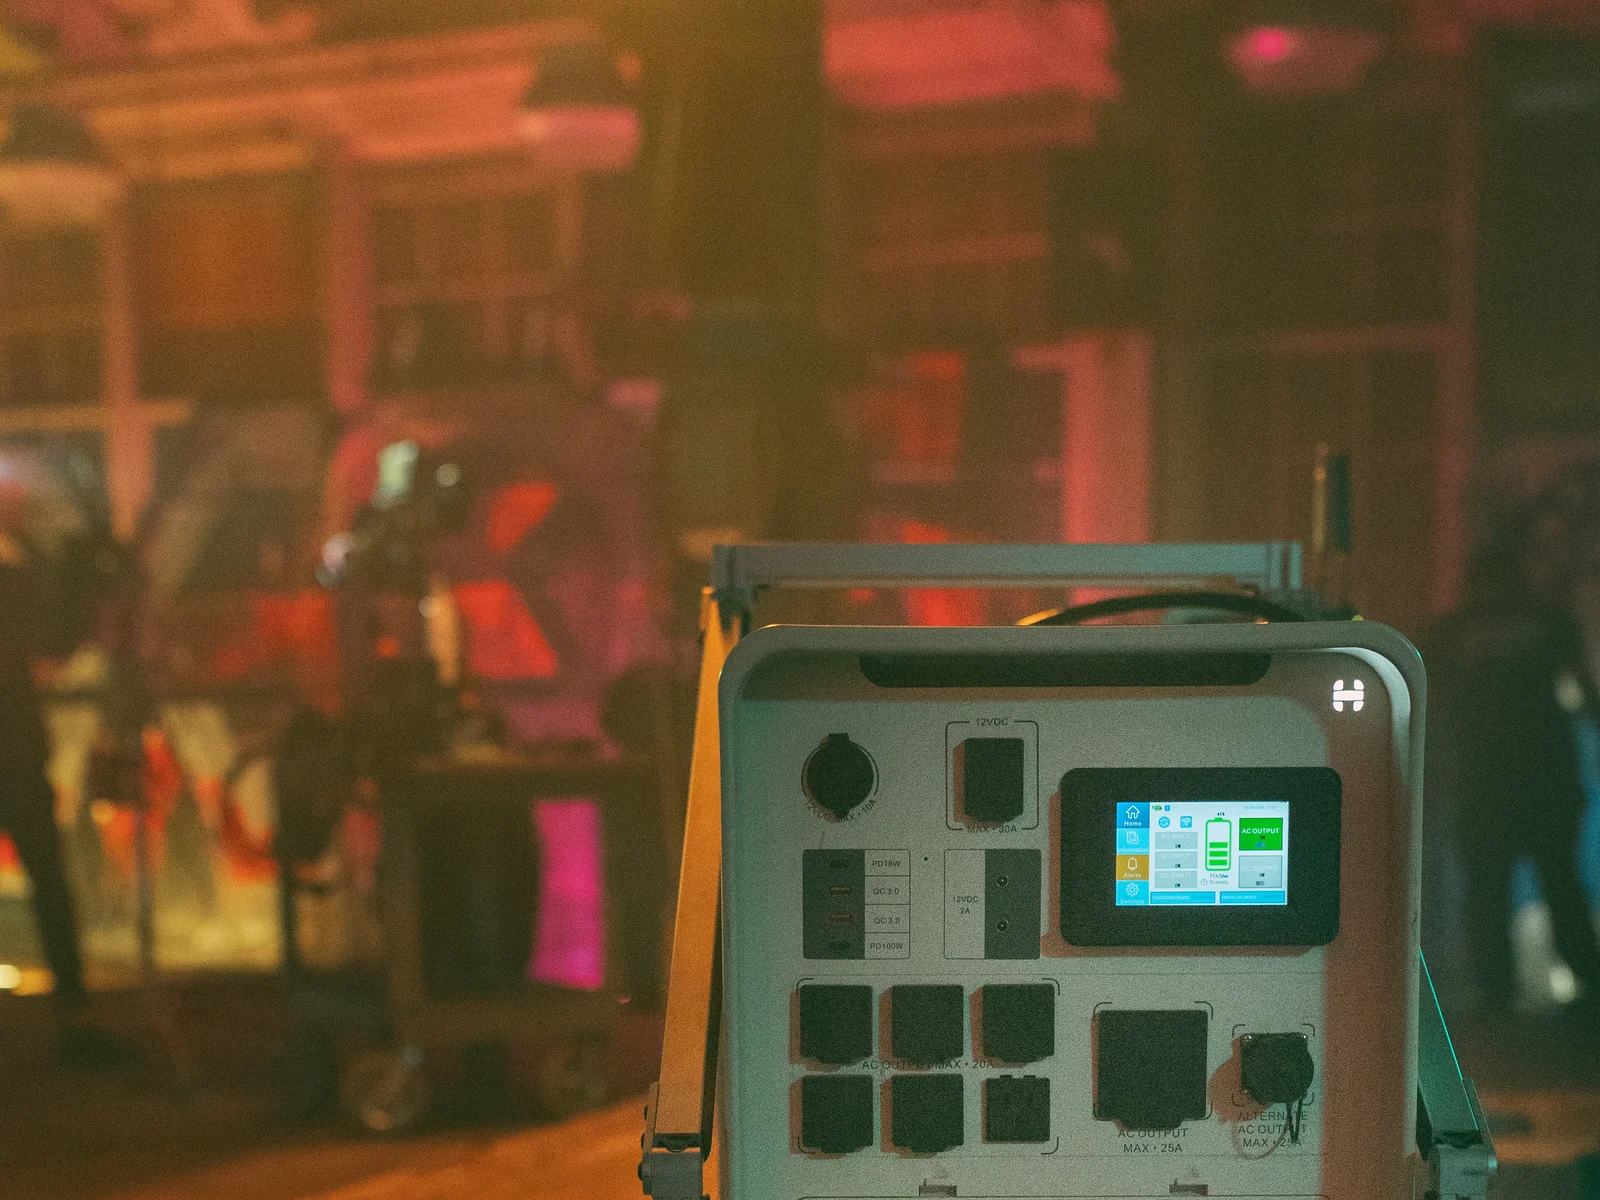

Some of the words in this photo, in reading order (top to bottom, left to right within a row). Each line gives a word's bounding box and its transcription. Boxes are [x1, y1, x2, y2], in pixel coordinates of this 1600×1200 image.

[976, 717, 1008, 727] 12VDC
[862, 799, 878, 815] 10A
[967, 825, 989, 834] MAX
[999, 825, 1018, 833] 30A
[871, 859, 901, 867] PD18W
[952, 895, 979, 904] 12VDC
[960, 906, 971, 915] 2A
[869, 942, 904, 950] PD100W
[862, 1060, 879, 1069] AC
[972, 1060, 994, 1069] 20A
[1118, 1128, 1136, 1139] AC
[1138, 1127, 1189, 1138] OUTPUT
[1238, 1124, 1255, 1134] AC
[1242, 1138, 1269, 1147] MAX
[1123, 1143, 1150, 1153] MAX
[1160, 1143, 1183, 1153] 25A
